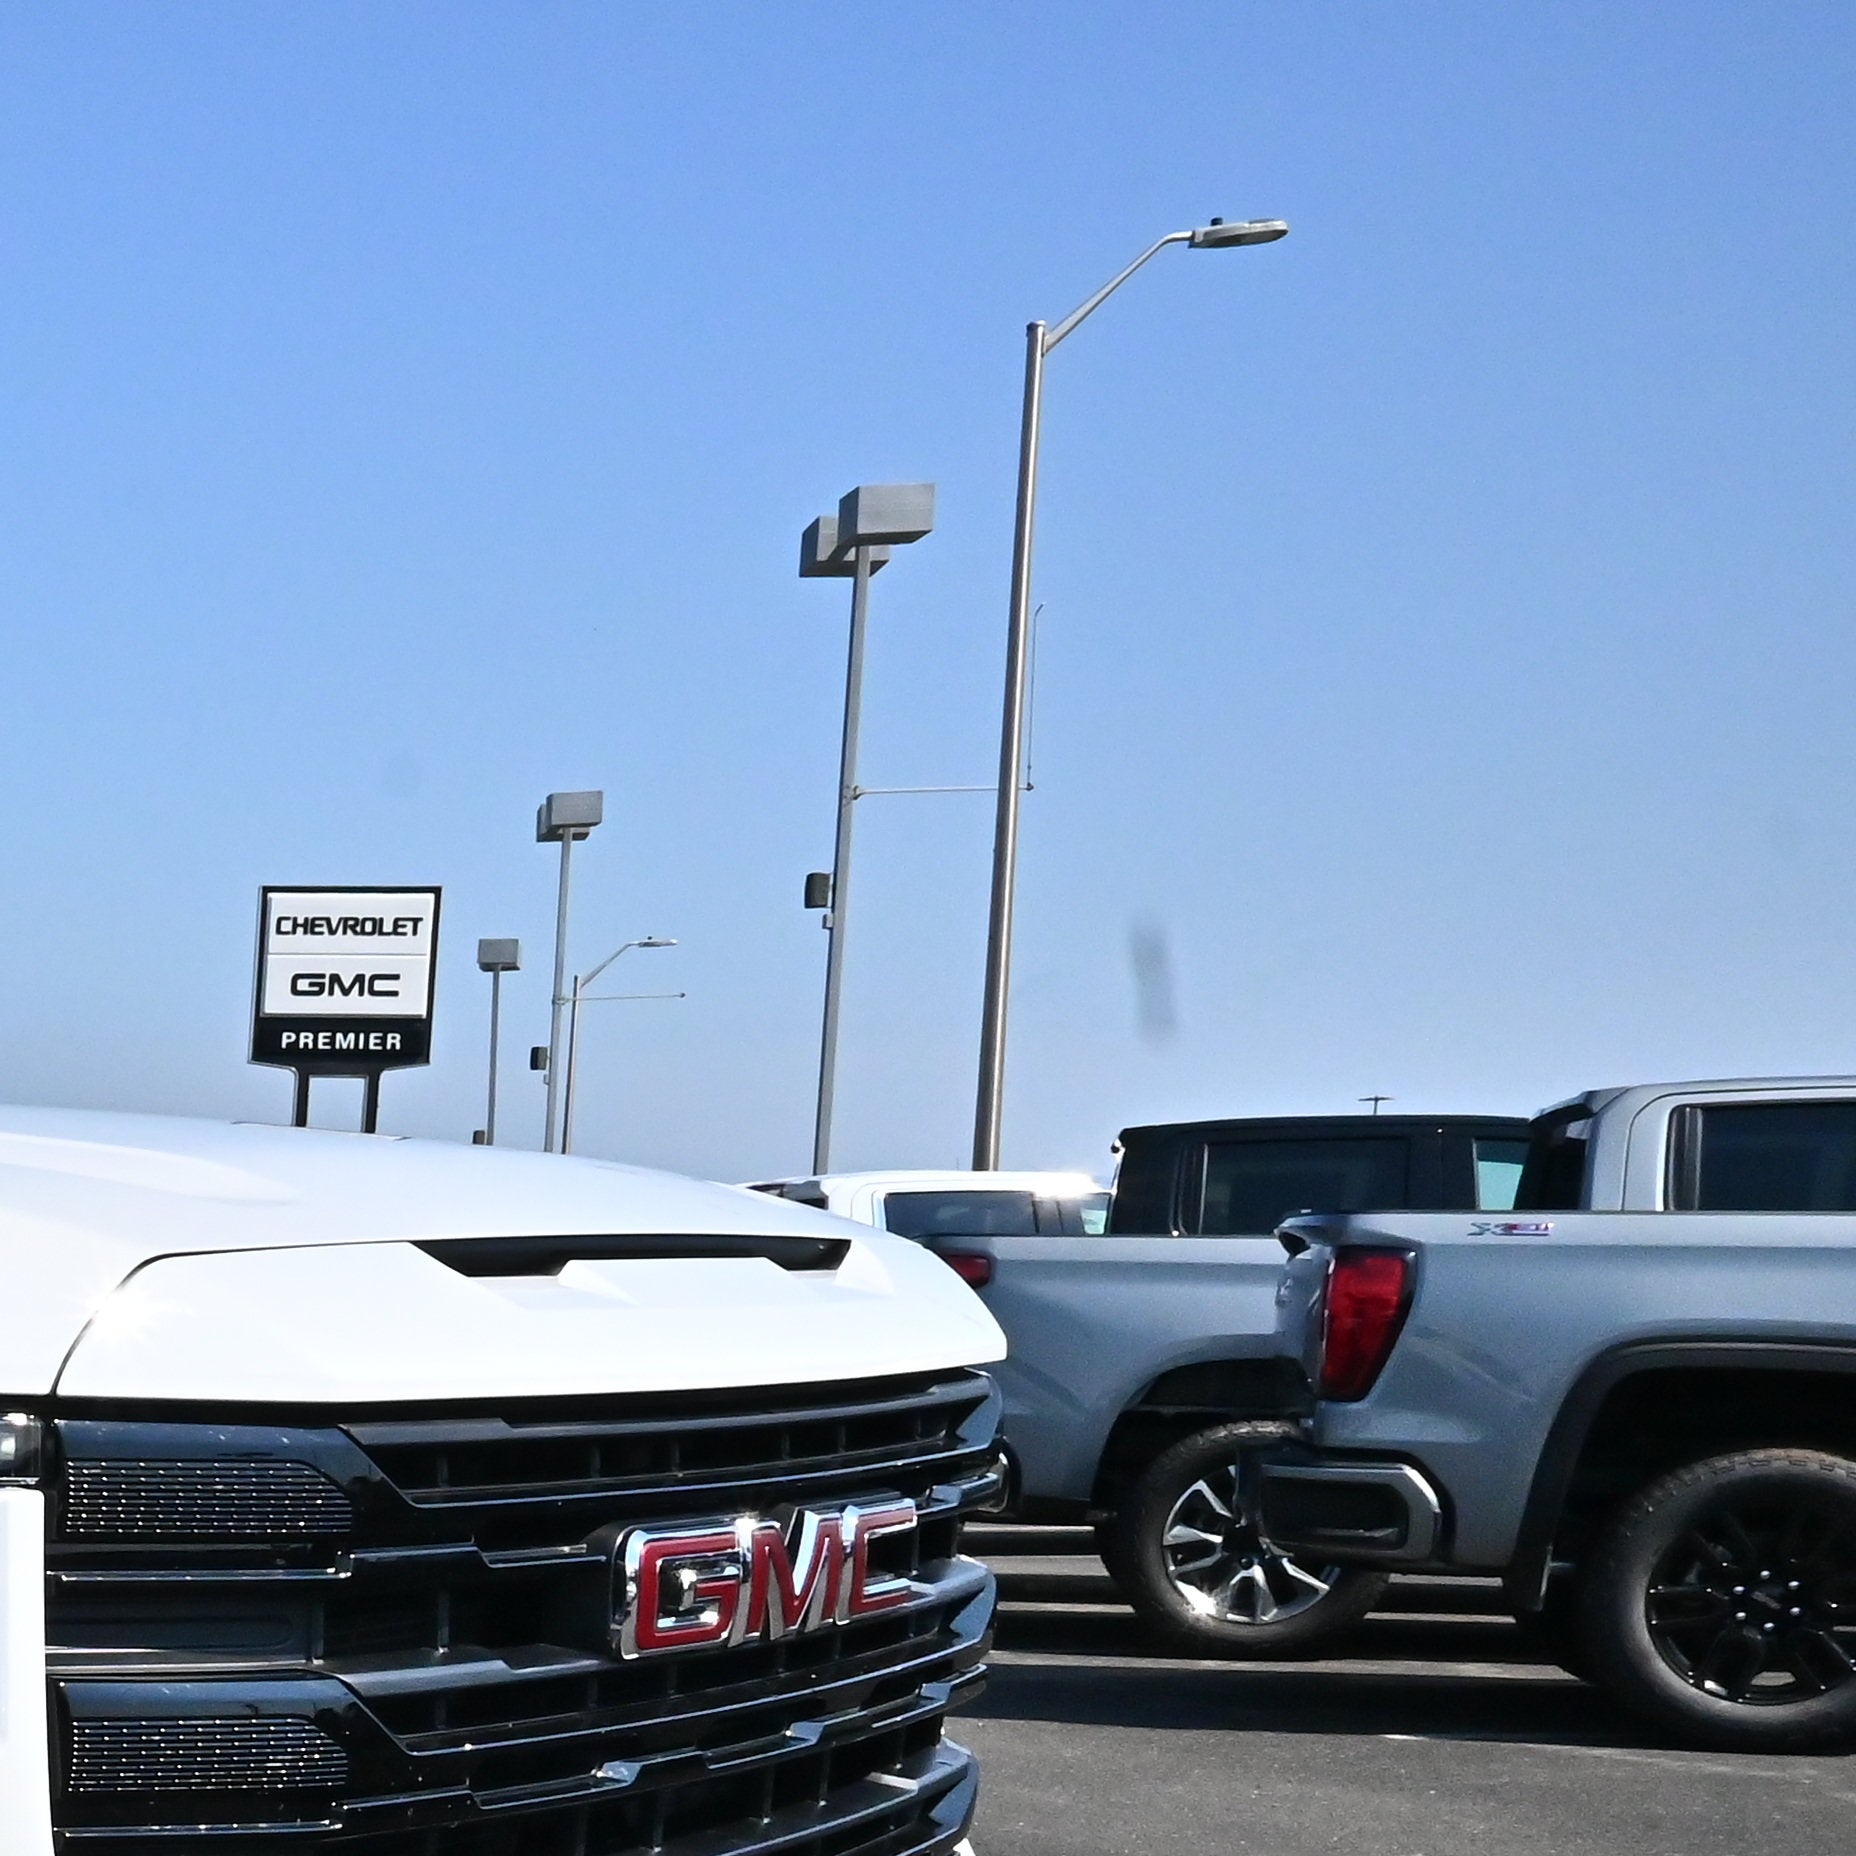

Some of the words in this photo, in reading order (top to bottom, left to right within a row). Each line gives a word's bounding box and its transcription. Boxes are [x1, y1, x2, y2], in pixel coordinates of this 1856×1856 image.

[275, 916, 424, 937] CHEVROLET
[290, 973, 401, 997] GMC
[281, 1031, 402, 1051] PREMIER
[620, 1498, 918, 1660] GMC
